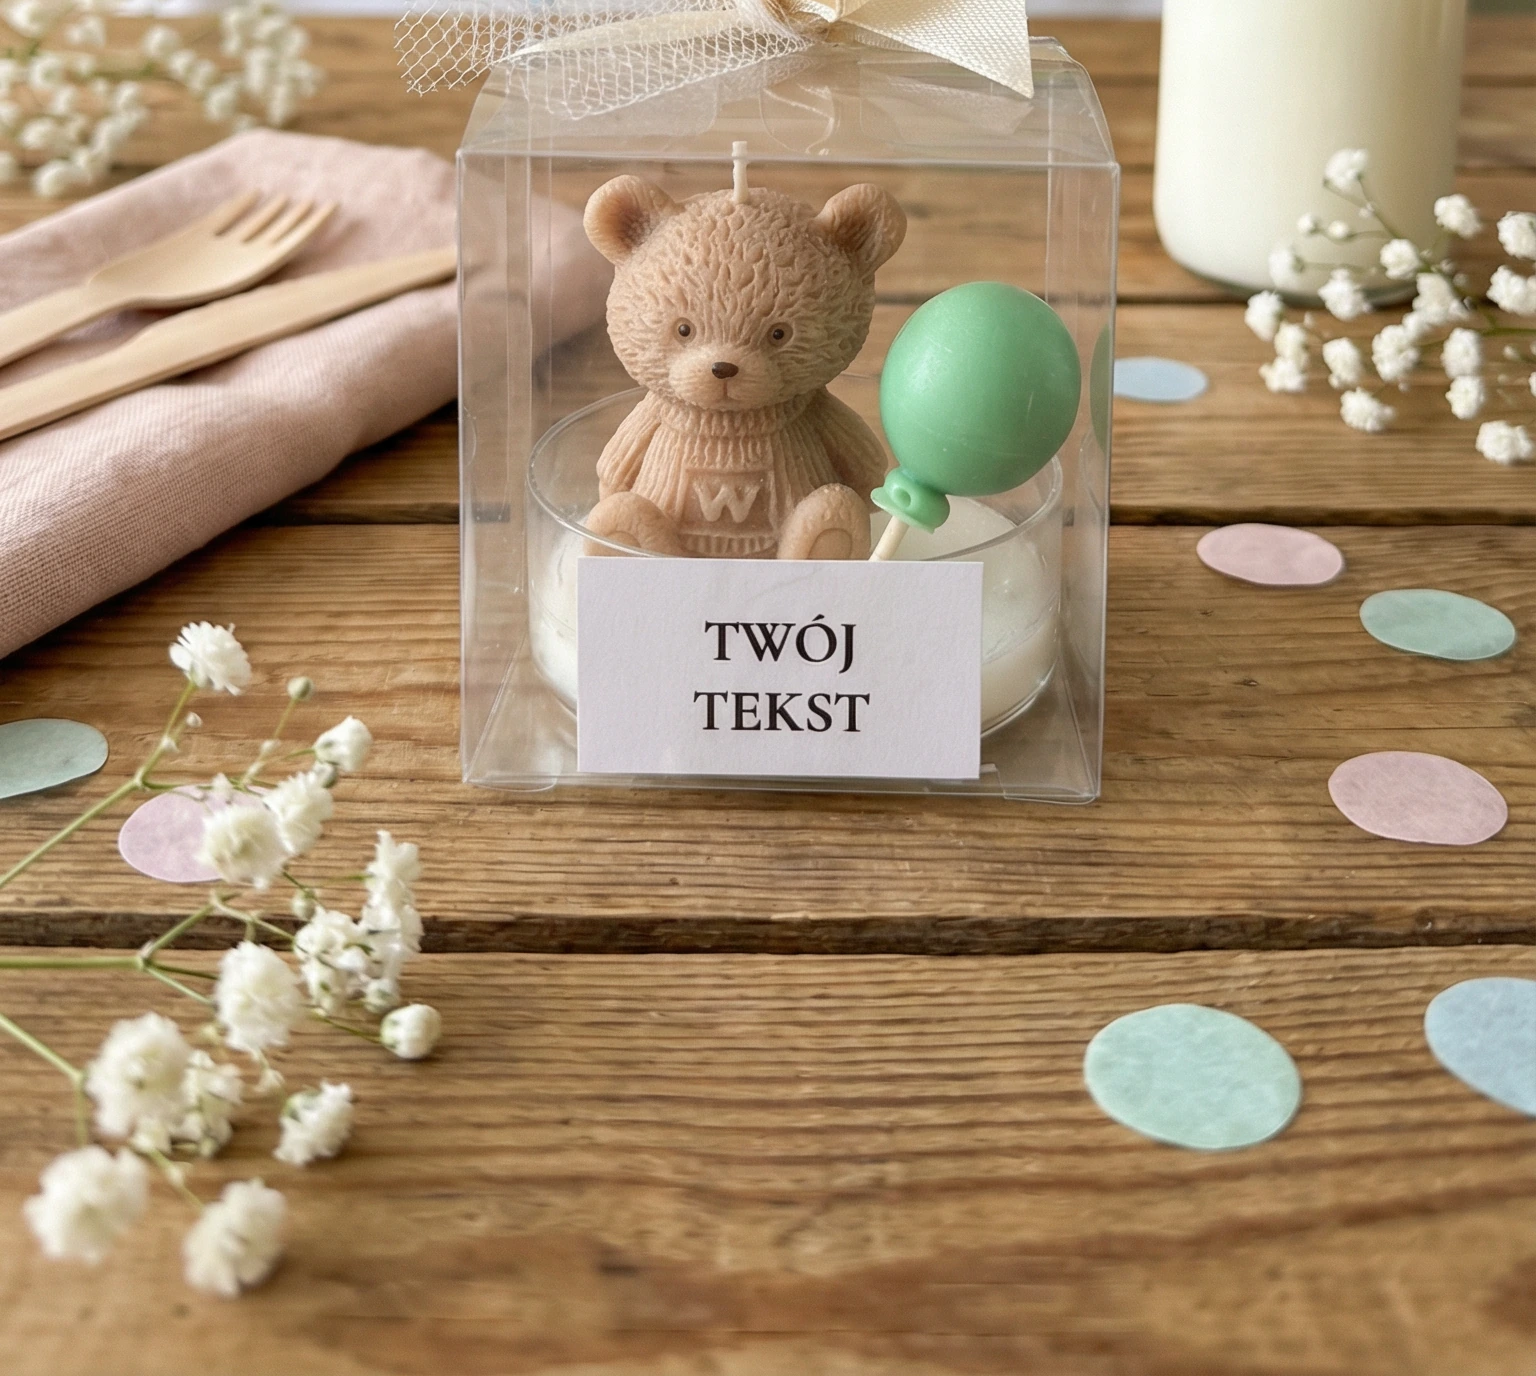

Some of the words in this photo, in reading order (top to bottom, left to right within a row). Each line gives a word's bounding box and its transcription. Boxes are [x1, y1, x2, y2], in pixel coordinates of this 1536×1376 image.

[694, 479, 760, 523] W
[704, 614, 857, 674] TWÓJ
[693, 690, 870, 733] TEKST
